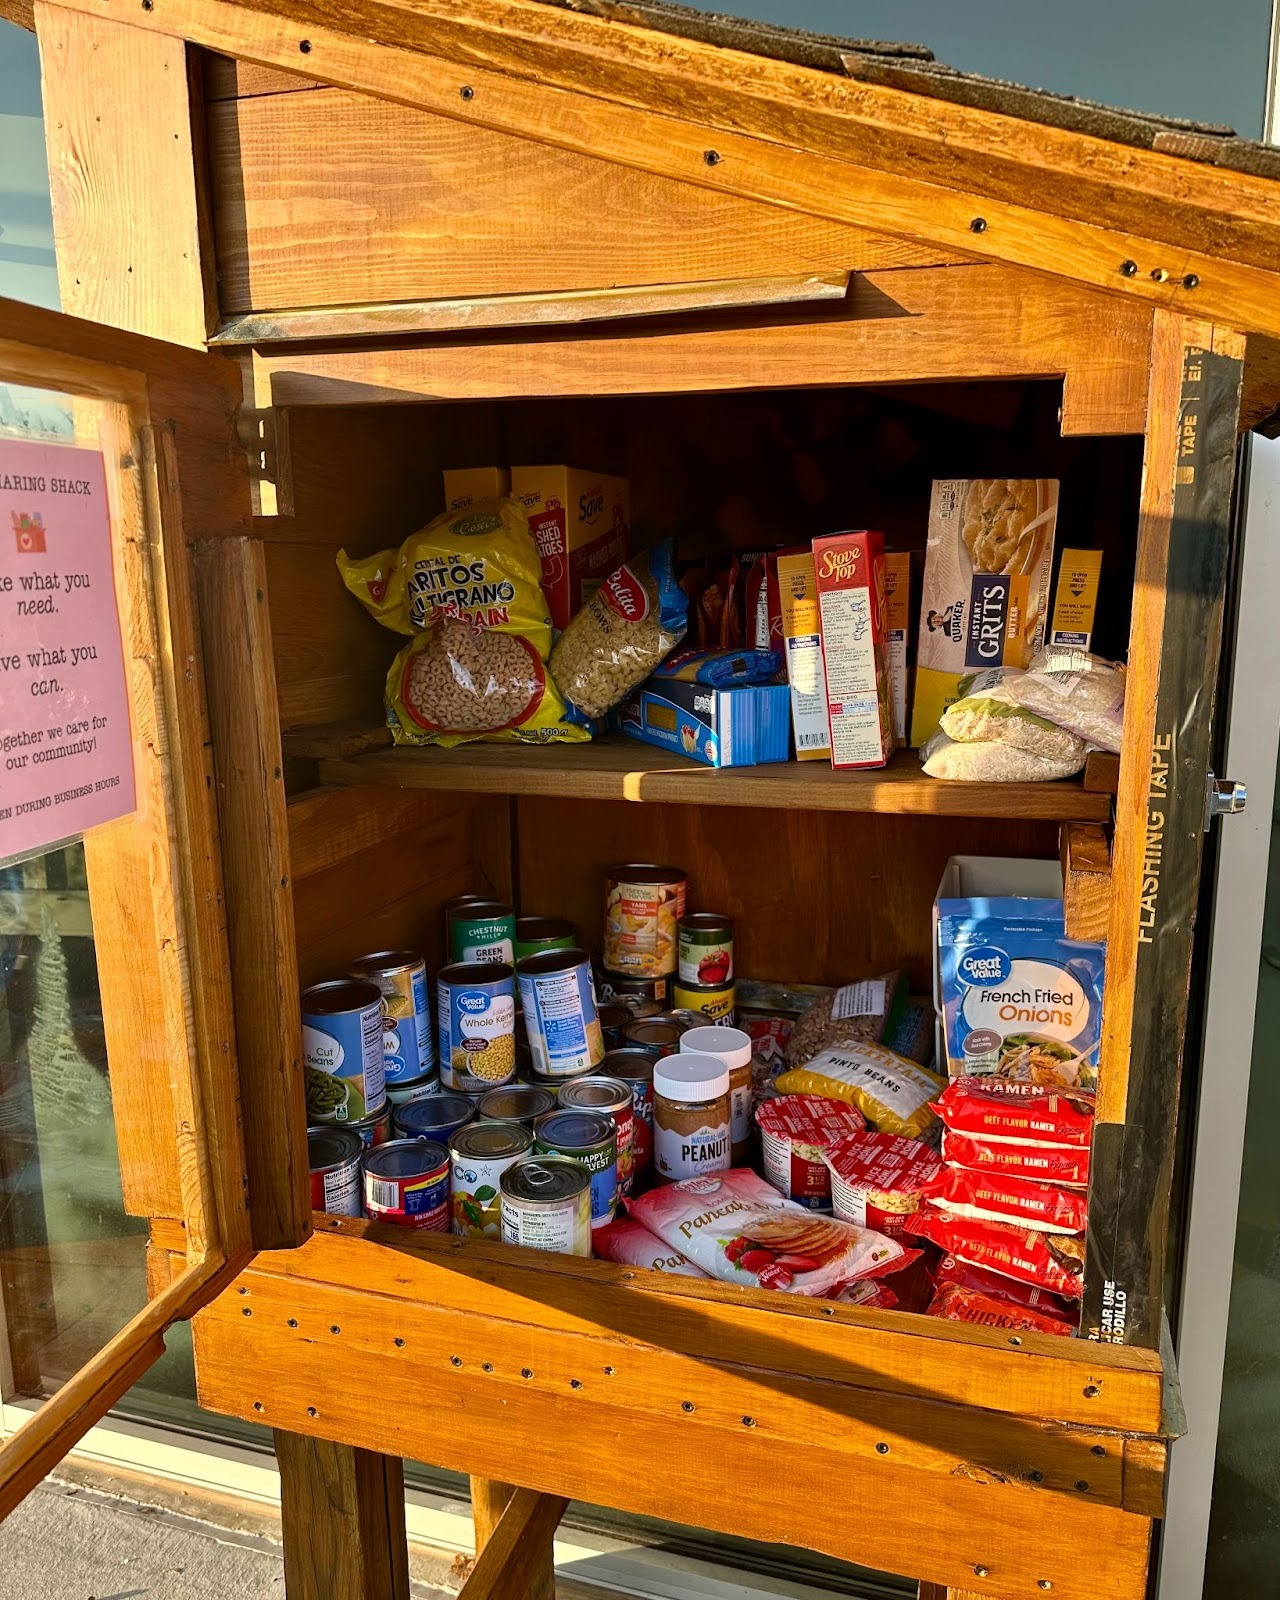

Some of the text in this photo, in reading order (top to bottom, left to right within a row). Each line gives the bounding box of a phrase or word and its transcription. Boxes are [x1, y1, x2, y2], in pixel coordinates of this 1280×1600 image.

[1181, 415, 1197, 457] TAPE
[51, 478, 91, 495] SHACK
[578, 494, 604, 522] Save
[448, 554, 461, 564] DE
[819, 547, 861, 578] Stove
[835, 563, 856, 583] Top
[19, 571, 61, 590] what
[64, 574, 91, 593] you
[17, 595, 58, 615] need.
[951, 600, 965, 642] QUAKER
[971, 601, 982, 639] INSTANT
[977, 585, 1005, 658] GRITS
[1008, 606, 1018, 639] BUTTER
[0, 645, 98, 671] ve what you
[31, 679, 64, 696] can.
[47, 727, 63, 740] we
[66, 721, 89, 736] care
[92, 716, 107, 729] for
[541, 728, 559, 736] 500
[6, 736, 98, 770] our community!
[16, 797, 52, 816] DURING
[54, 783, 94, 805] BUSINESS
[95, 775, 120, 792] HOURS
[1136, 733, 1171, 943] FLASHING TAPE
[468, 926, 508, 937] CHESTNUT
[476, 947, 503, 957] GREEN
[963, 955, 1001, 970] Great
[972, 967, 1002, 979] Value
[461, 996, 485, 1005] Great
[981, 989, 1073, 1006] French Fried
[701, 1001, 729, 1016] Save
[999, 1005, 1072, 1027] Onions
[465, 1011, 513, 1028] Whole Kerne
[307, 1053, 334, 1066] Beans
[316, 1047, 333, 1056] Cut
[828, 1056, 860, 1071] PINTO
[864, 1068, 902, 1093] BEANS
[981, 1084, 1044, 1095] RAMEN
[984, 1115, 1001, 1124] BEEF
[1002, 1116, 1029, 1128] FLAVOR
[1030, 1121, 1055, 1132] RAMEN
[682, 1137, 727, 1161] PEANUT
[847, 1142, 864, 1157] RICE
[889, 1137, 906, 1152] RICE
[908, 1160, 926, 1176] RICE
[978, 1153, 995, 1163] BEEF
[997, 1153, 1023, 1165] FLAVOR
[1024, 1157, 1049, 1168] RAMEN
[325, 1167, 351, 1181] Nutrition
[806, 1176, 814, 1185] 3
[864, 1166, 882, 1181] RICE
[326, 1189, 350, 1202] Calories
[975, 1189, 993, 1200] BEEF
[993, 1193, 1019, 1206] FLAVOR
[1019, 1198, 1045, 1211] RAMEN
[502, 1201, 520, 1218] Facts
[510, 1230, 520, 1242] 165
[884, 1227, 892, 1236] 3
[968, 1242, 1038, 1273] BEEF FLAVOR RAMEN
[761, 1267, 781, 1283] Water
[1102, 1280, 1115, 1306] USE
[1112, 1291, 1127, 1345] RODILLO
